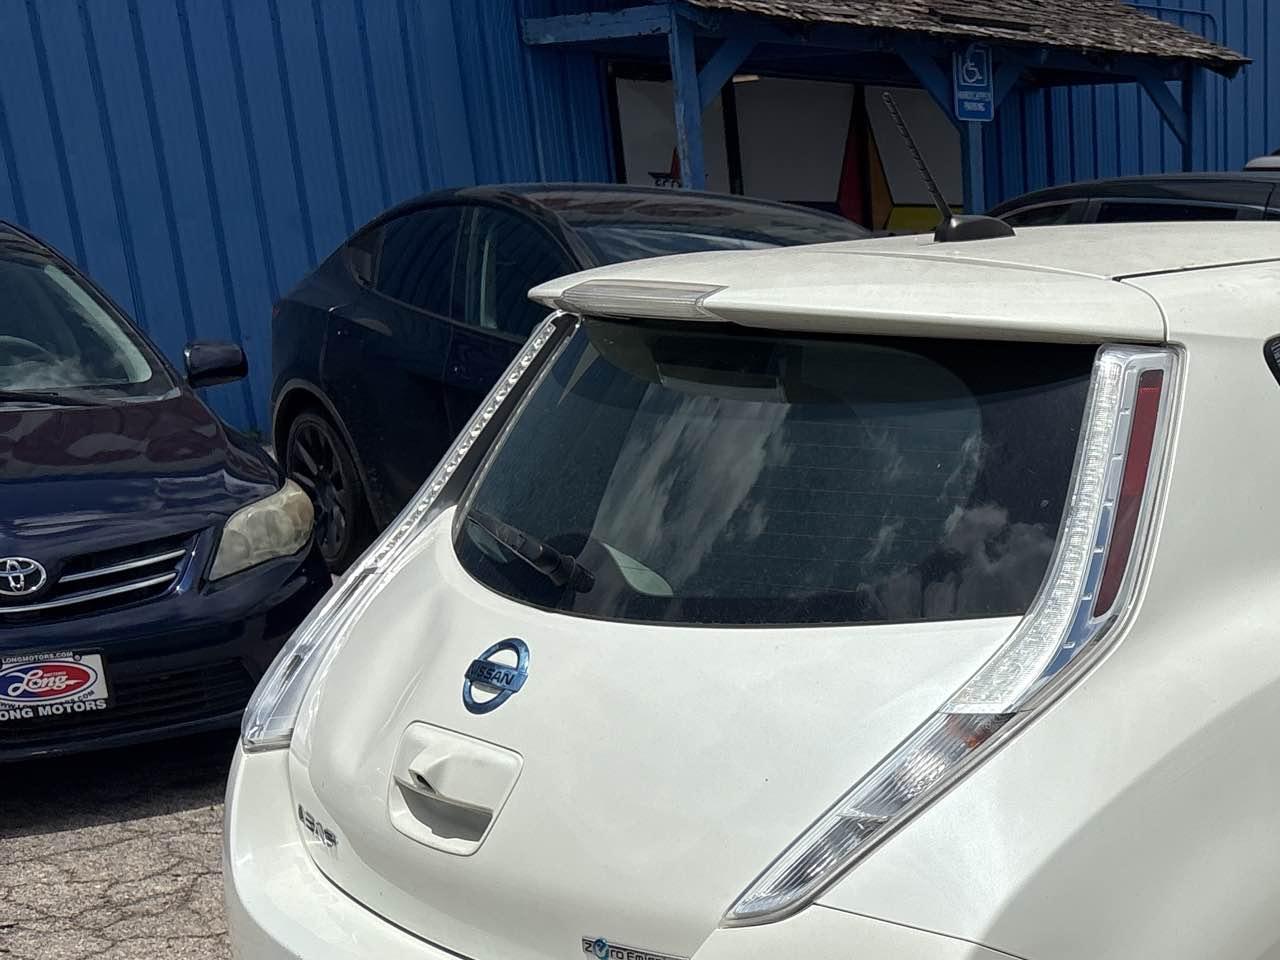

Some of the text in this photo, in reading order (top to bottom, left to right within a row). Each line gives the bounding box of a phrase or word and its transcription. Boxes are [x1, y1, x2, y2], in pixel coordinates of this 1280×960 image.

[469, 664, 515, 685] NISSAN
[0, 708, 37, 722] ONG
[38, 700, 107, 717] MOTORS
